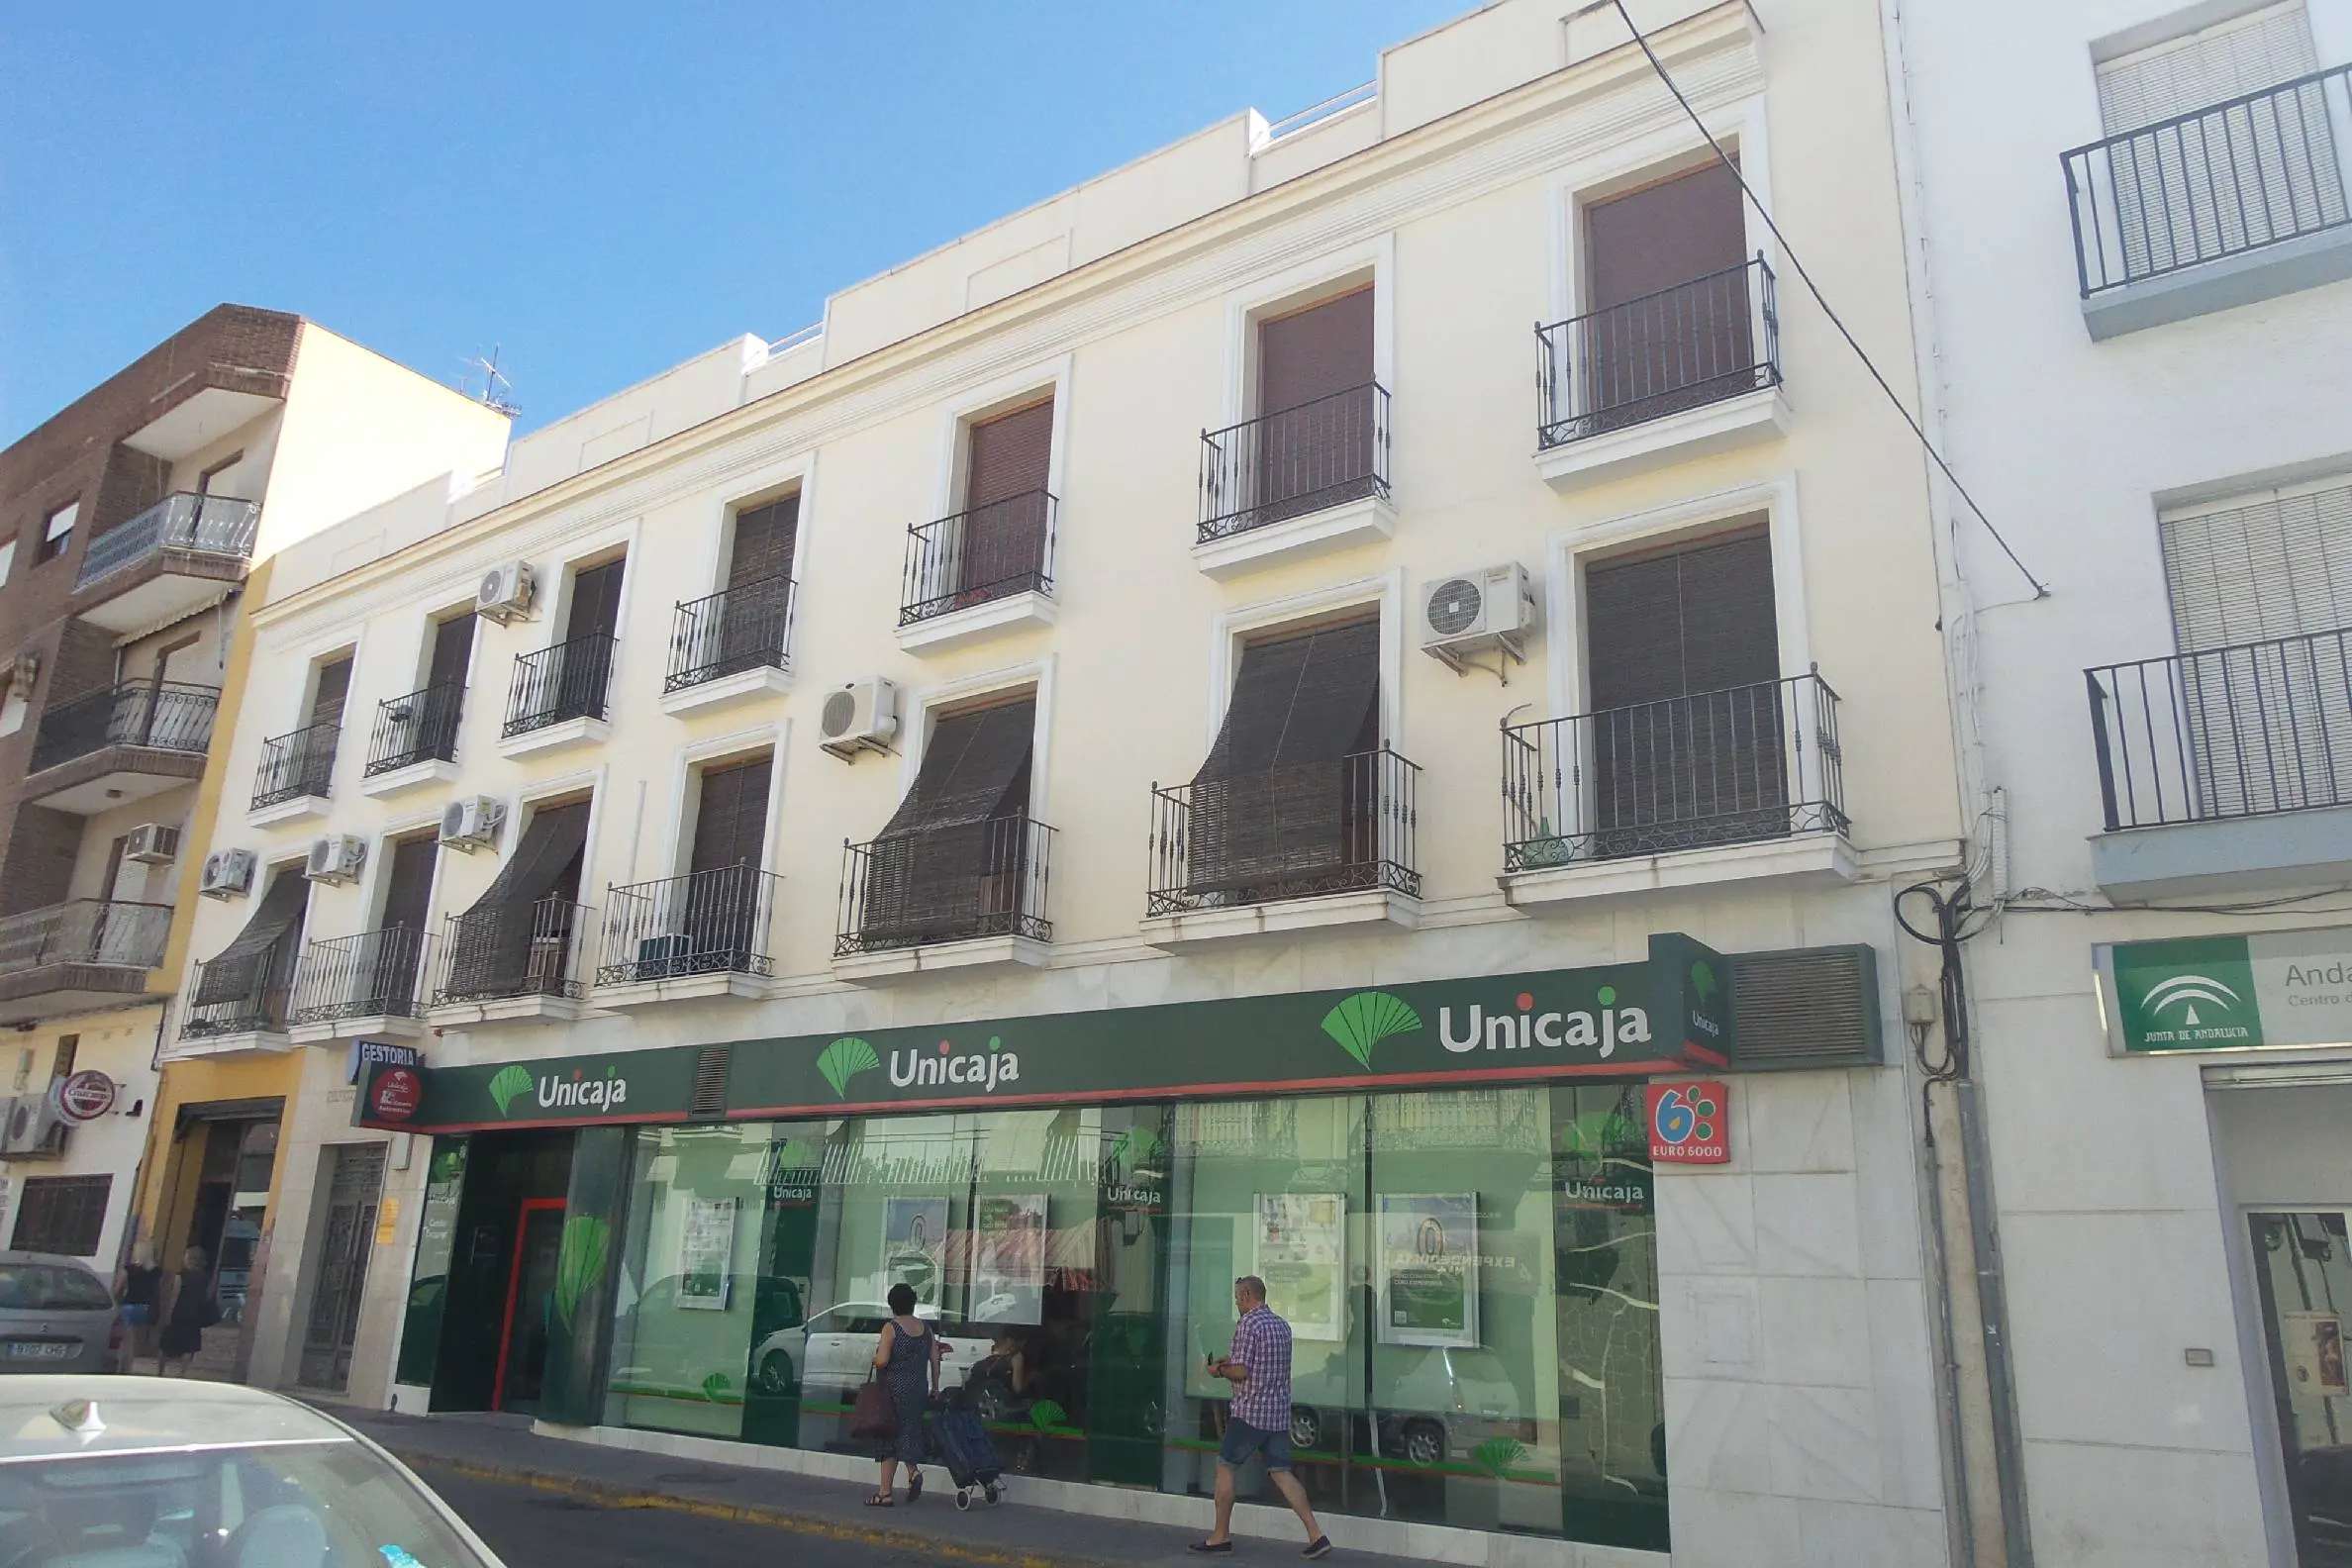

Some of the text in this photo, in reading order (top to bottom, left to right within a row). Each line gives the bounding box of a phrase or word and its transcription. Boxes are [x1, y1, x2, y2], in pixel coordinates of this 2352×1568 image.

[2288, 995, 2340, 1007] Centro
[1439, 986, 1652, 1058] Unicaja
[1693, 1010, 1719, 1037] Unicaja
[2144, 1030, 2175, 1042] JUNTA
[2178, 1029, 2192, 1040] DE
[361, 1042, 414, 1066] GESTORIA
[891, 1035, 1019, 1093] Unicaja
[539, 1065, 626, 1113] Unicaja
[1653, 1145, 1722, 1157] EURO 6000
[773, 1185, 812, 1201] Unicaja
[1107, 1185, 1161, 1205] Unicaja
[1565, 1176, 1643, 1204] Unicaja
